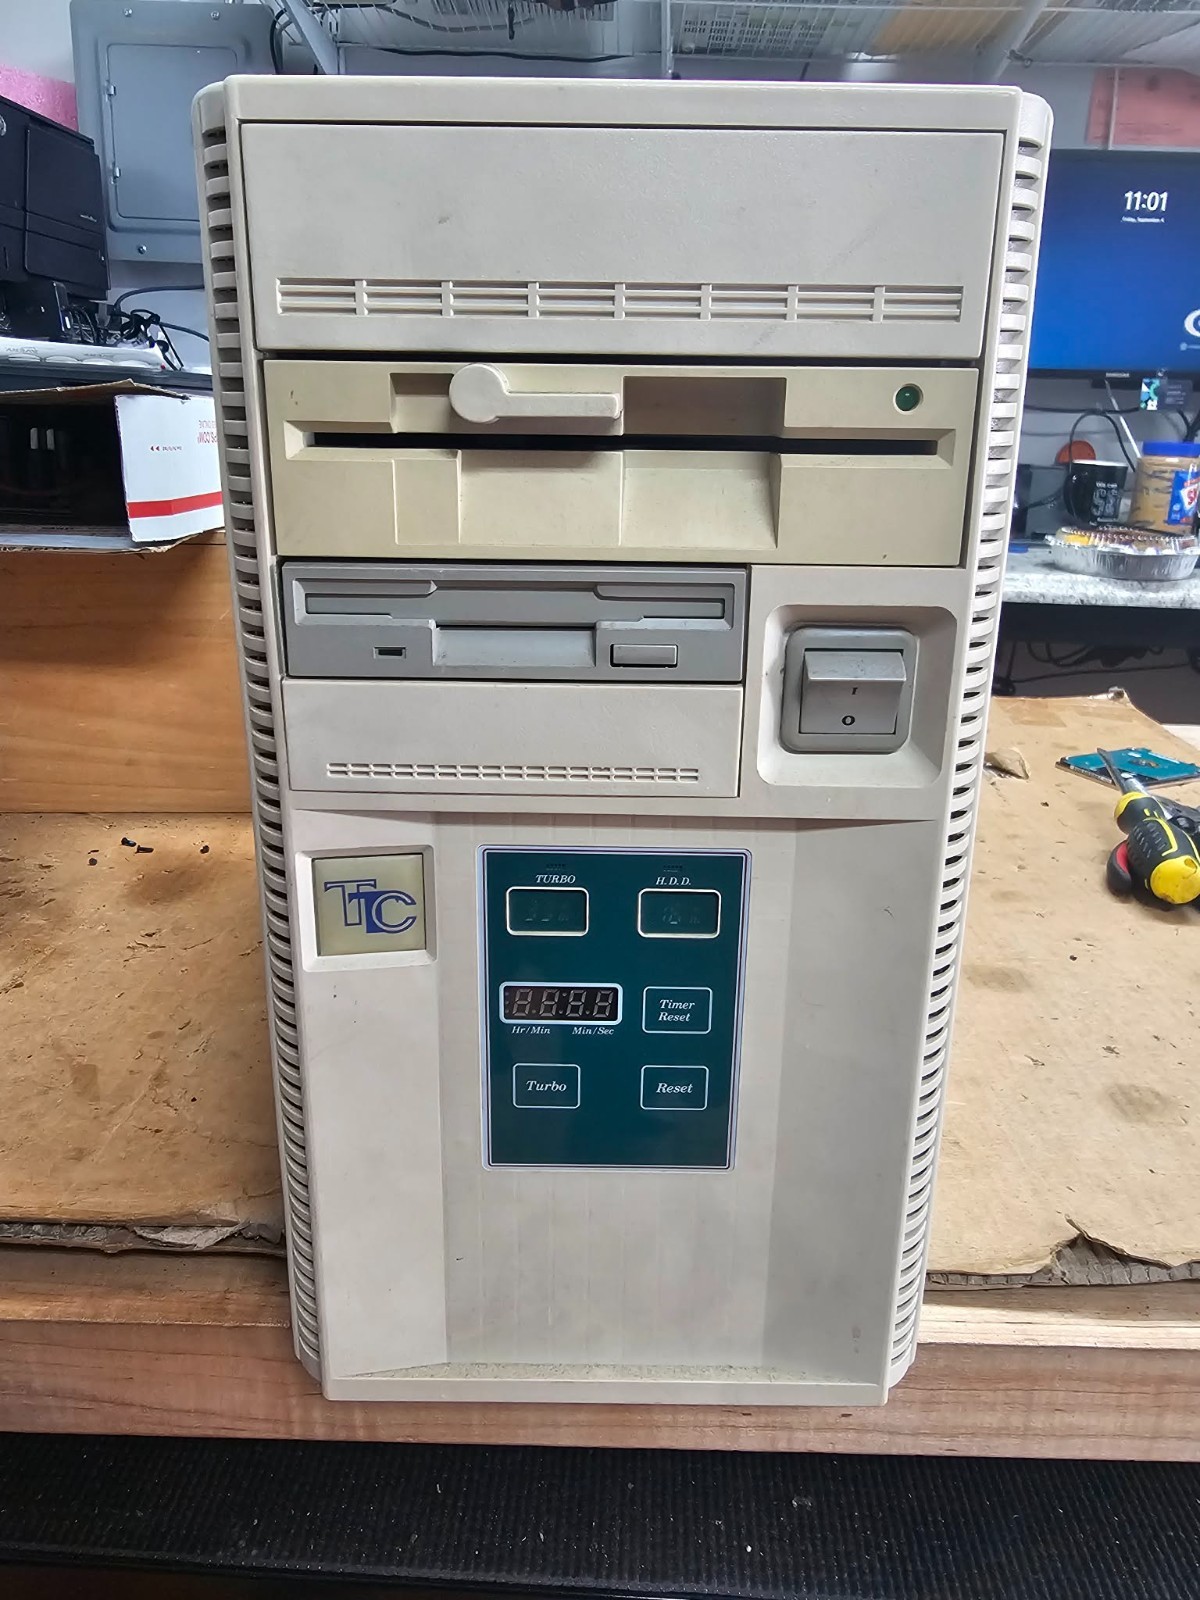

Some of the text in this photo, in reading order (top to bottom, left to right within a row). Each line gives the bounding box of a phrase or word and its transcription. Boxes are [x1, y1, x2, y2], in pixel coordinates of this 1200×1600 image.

[1124, 190, 1168, 212] 11:01
[535, 874, 577, 884] TURBO
[655, 876, 692, 886] H.D.D.
[659, 999, 696, 1010] Timer
[658, 1011, 691, 1022] Reset
[511, 1026, 551, 1035] Hr/Min
[572, 1026, 615, 1035] Min/Sec
[525, 1080, 567, 1092] Turbo
[656, 1082, 694, 1094] Reset
